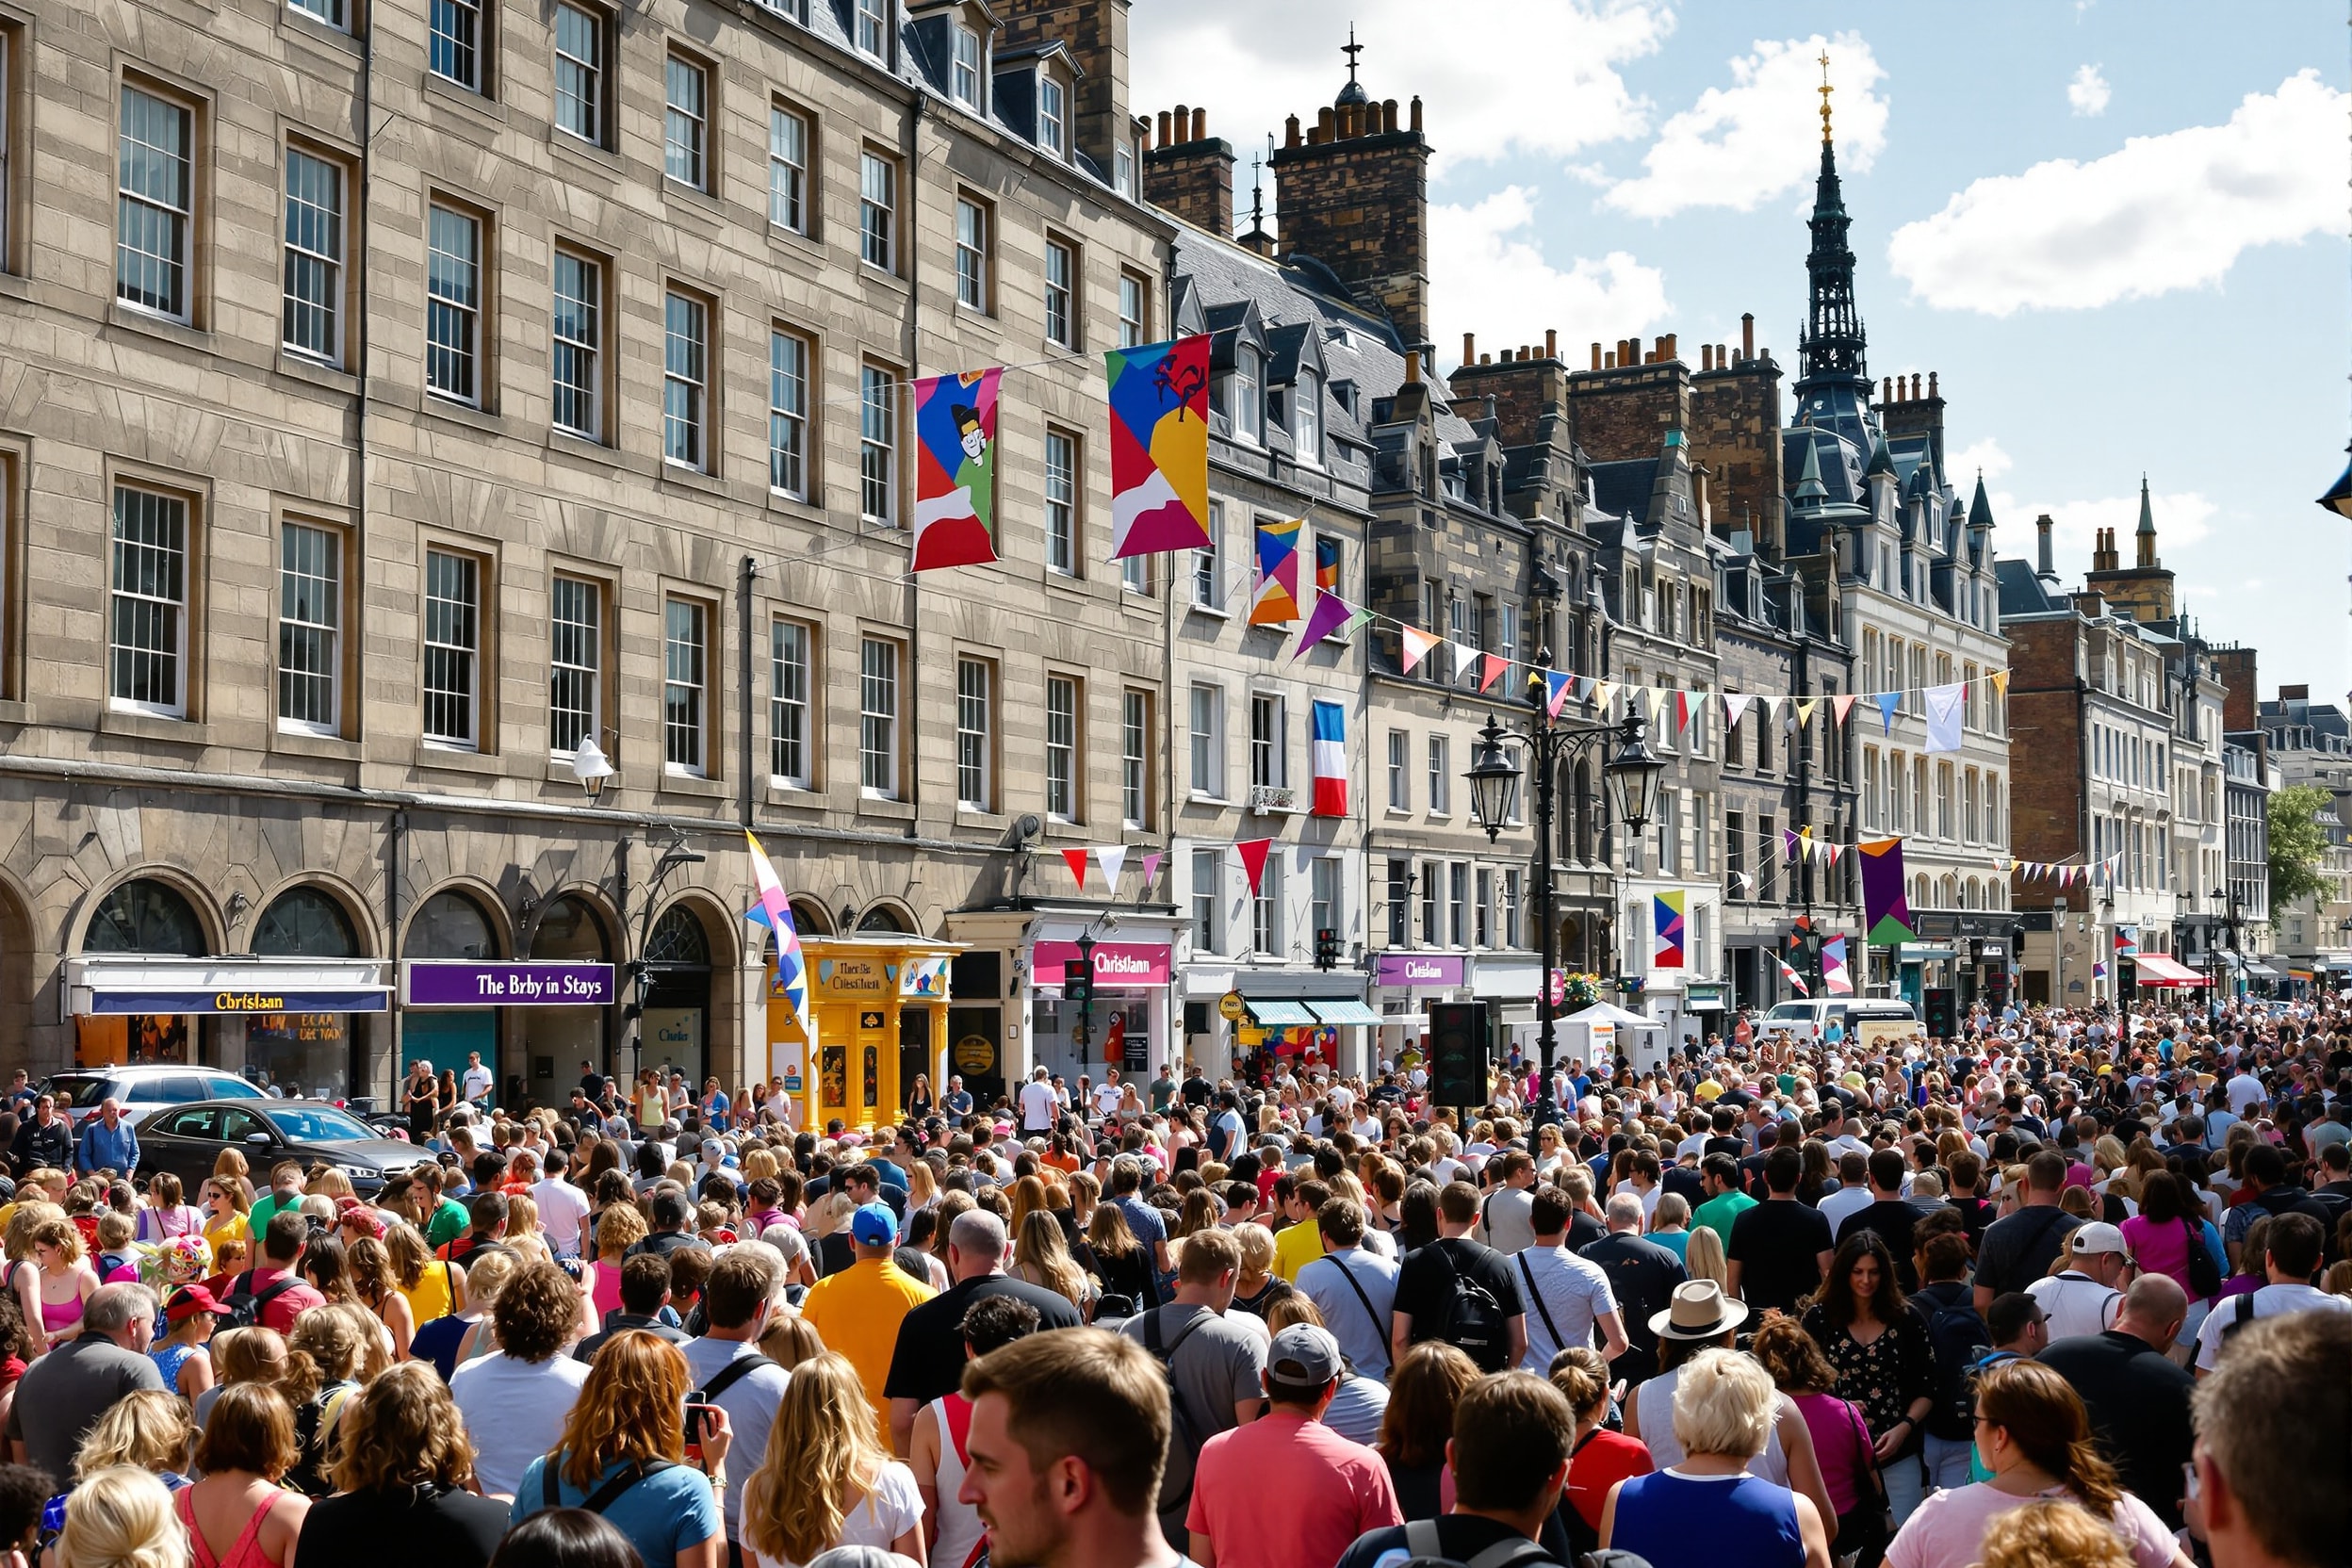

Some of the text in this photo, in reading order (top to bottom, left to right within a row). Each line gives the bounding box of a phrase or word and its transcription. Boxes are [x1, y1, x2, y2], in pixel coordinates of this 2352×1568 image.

[477, 973, 505, 995] The
[546, 975, 560, 995] in
[564, 974, 602, 1000] Stays
